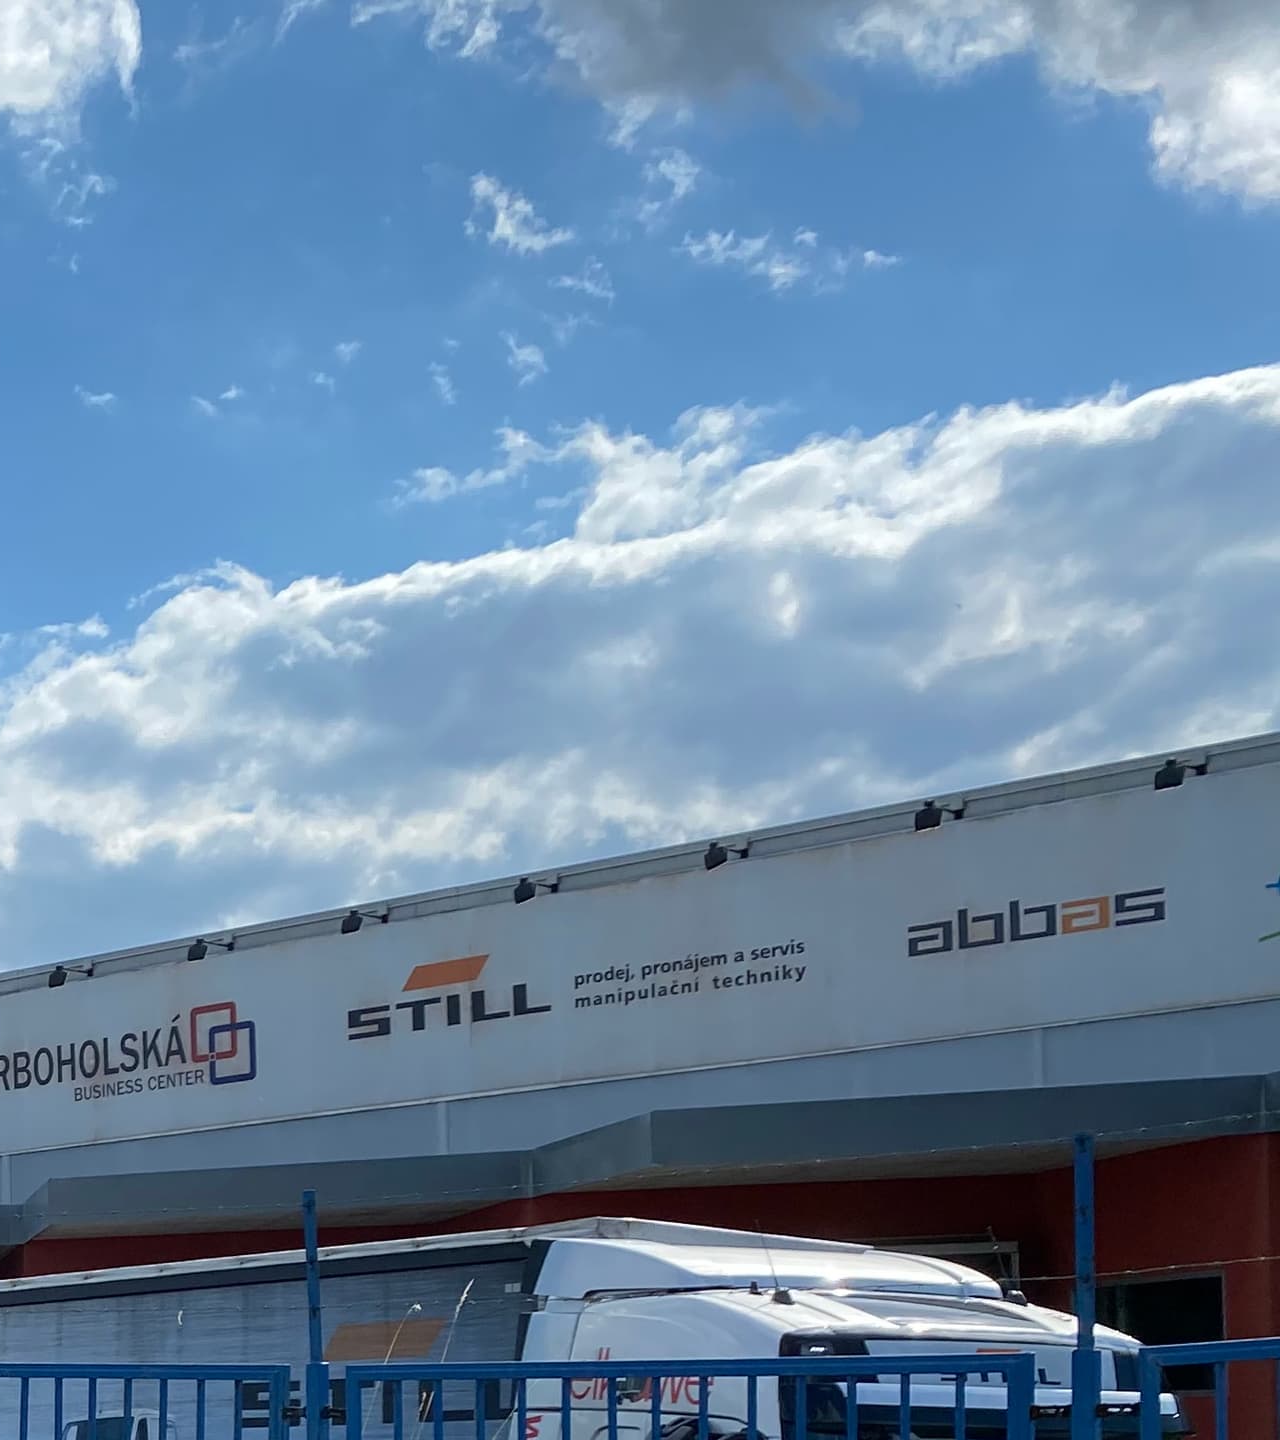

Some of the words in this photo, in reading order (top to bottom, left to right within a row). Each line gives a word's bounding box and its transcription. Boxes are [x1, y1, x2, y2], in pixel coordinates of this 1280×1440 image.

[907, 886, 1166, 957] abbas
[574, 962, 636, 990] prodej,
[641, 949, 728, 982] pronájem
[733, 949, 745, 963] a
[750, 938, 806, 962] servis
[574, 978, 700, 1009] manipulační
[711, 962, 808, 992] techniky
[347, 983, 552, 1041] STILL
[73, 1079, 144, 1102] BUSINESS
[147, 1069, 205, 1091] CENTER
